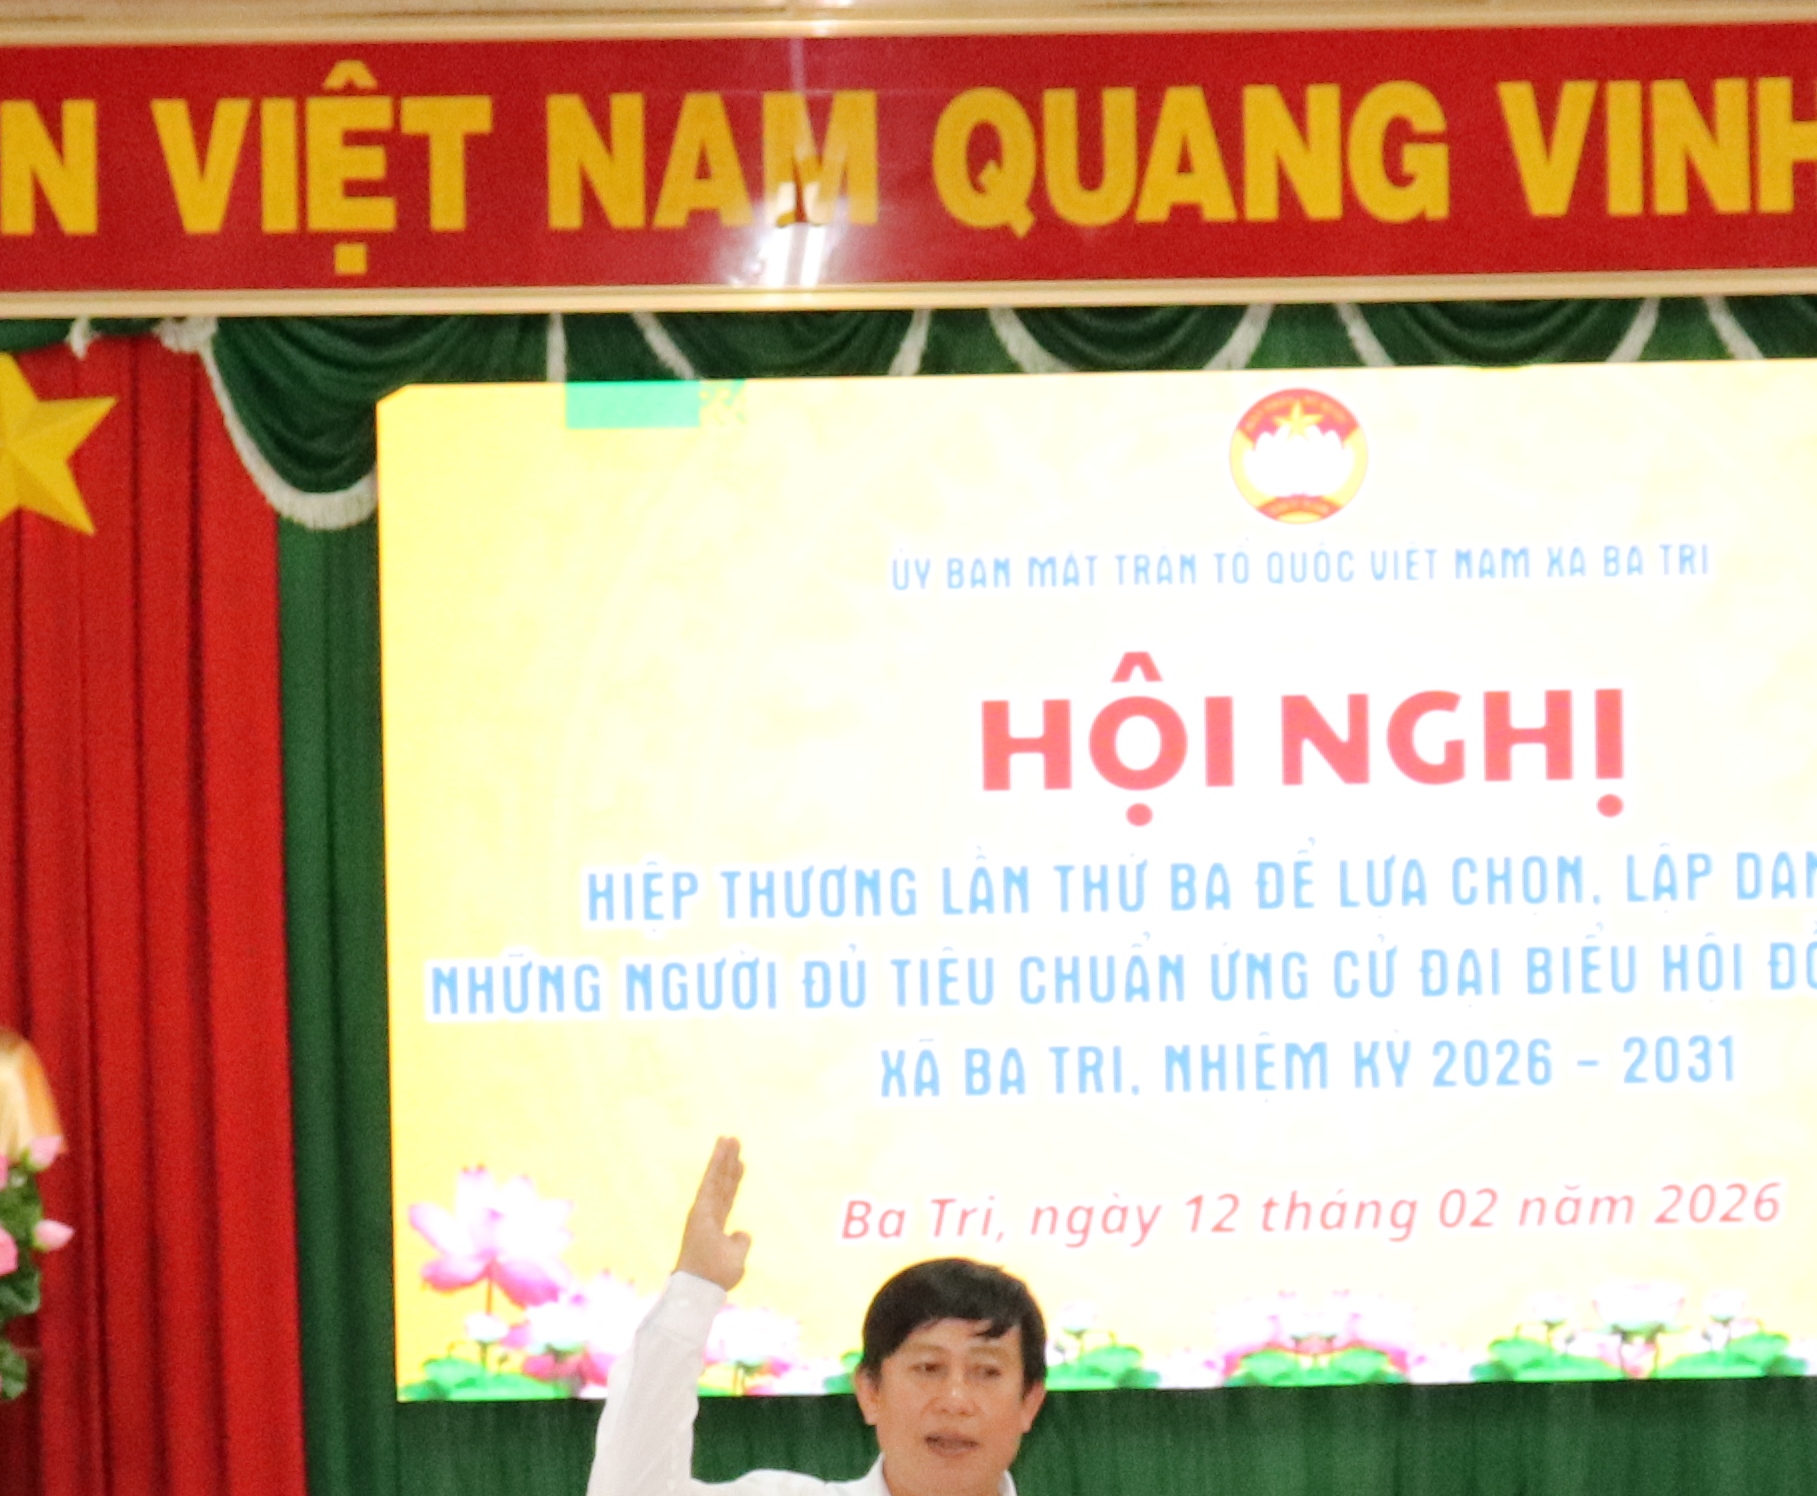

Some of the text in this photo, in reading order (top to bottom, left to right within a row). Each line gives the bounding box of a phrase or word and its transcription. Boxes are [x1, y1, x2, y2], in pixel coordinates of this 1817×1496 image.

[150, 62, 492, 274] VIỆT
[546, 90, 886, 231] NAM
[932, 82, 1450, 236] QUANG
[947, 557, 1011, 589] BAN
[1455, 547, 1530, 579] NAM
[1604, 545, 1643, 577] BA
[1659, 544, 1708, 575] TRI
[981, 651, 1624, 827] HỘI NGHỊ
[720, 865, 917, 919] THƯƠNG
[1170, 862, 1231, 911] BA
[964, 1047, 1026, 1096] BA
[1432, 1038, 1552, 1088] 2026
[1623, 1034, 1734, 1084] 2031
[842, 1183, 1779, 1248] Ba Tri, ngày 12 tháng 02 năm 2026
